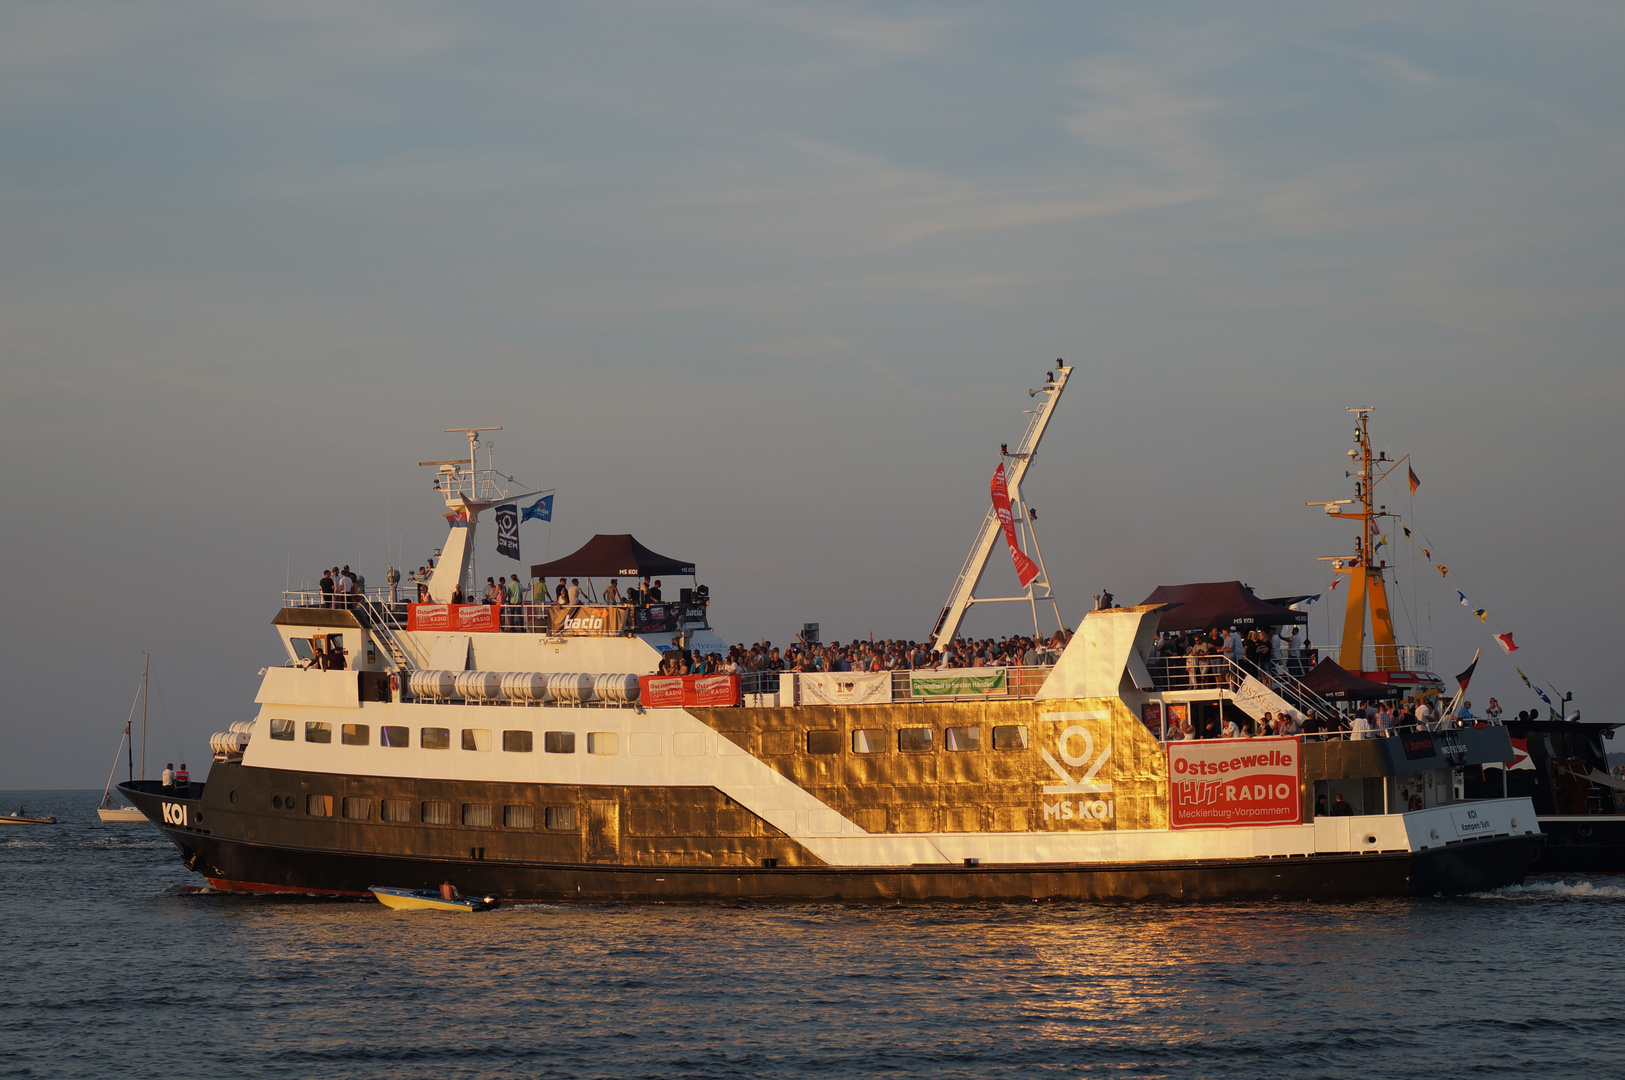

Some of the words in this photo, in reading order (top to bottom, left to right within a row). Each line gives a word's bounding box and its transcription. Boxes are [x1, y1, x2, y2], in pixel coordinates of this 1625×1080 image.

[564, 614, 603, 630] bacio
[913, 682, 945, 690] Gesundheit
[972, 680, 995, 688] Händen
[1174, 750, 1292, 776] Ostseewelle
[1177, 778, 1291, 806] HIT-RADIO
[161, 801, 188, 826] KOI
[1043, 800, 1073, 820] MS
[1079, 800, 1114, 819] KOI
[1178, 806, 1290, 819] Mecklenburg-Vorpommern
[1467, 810, 1478, 819] KOI
